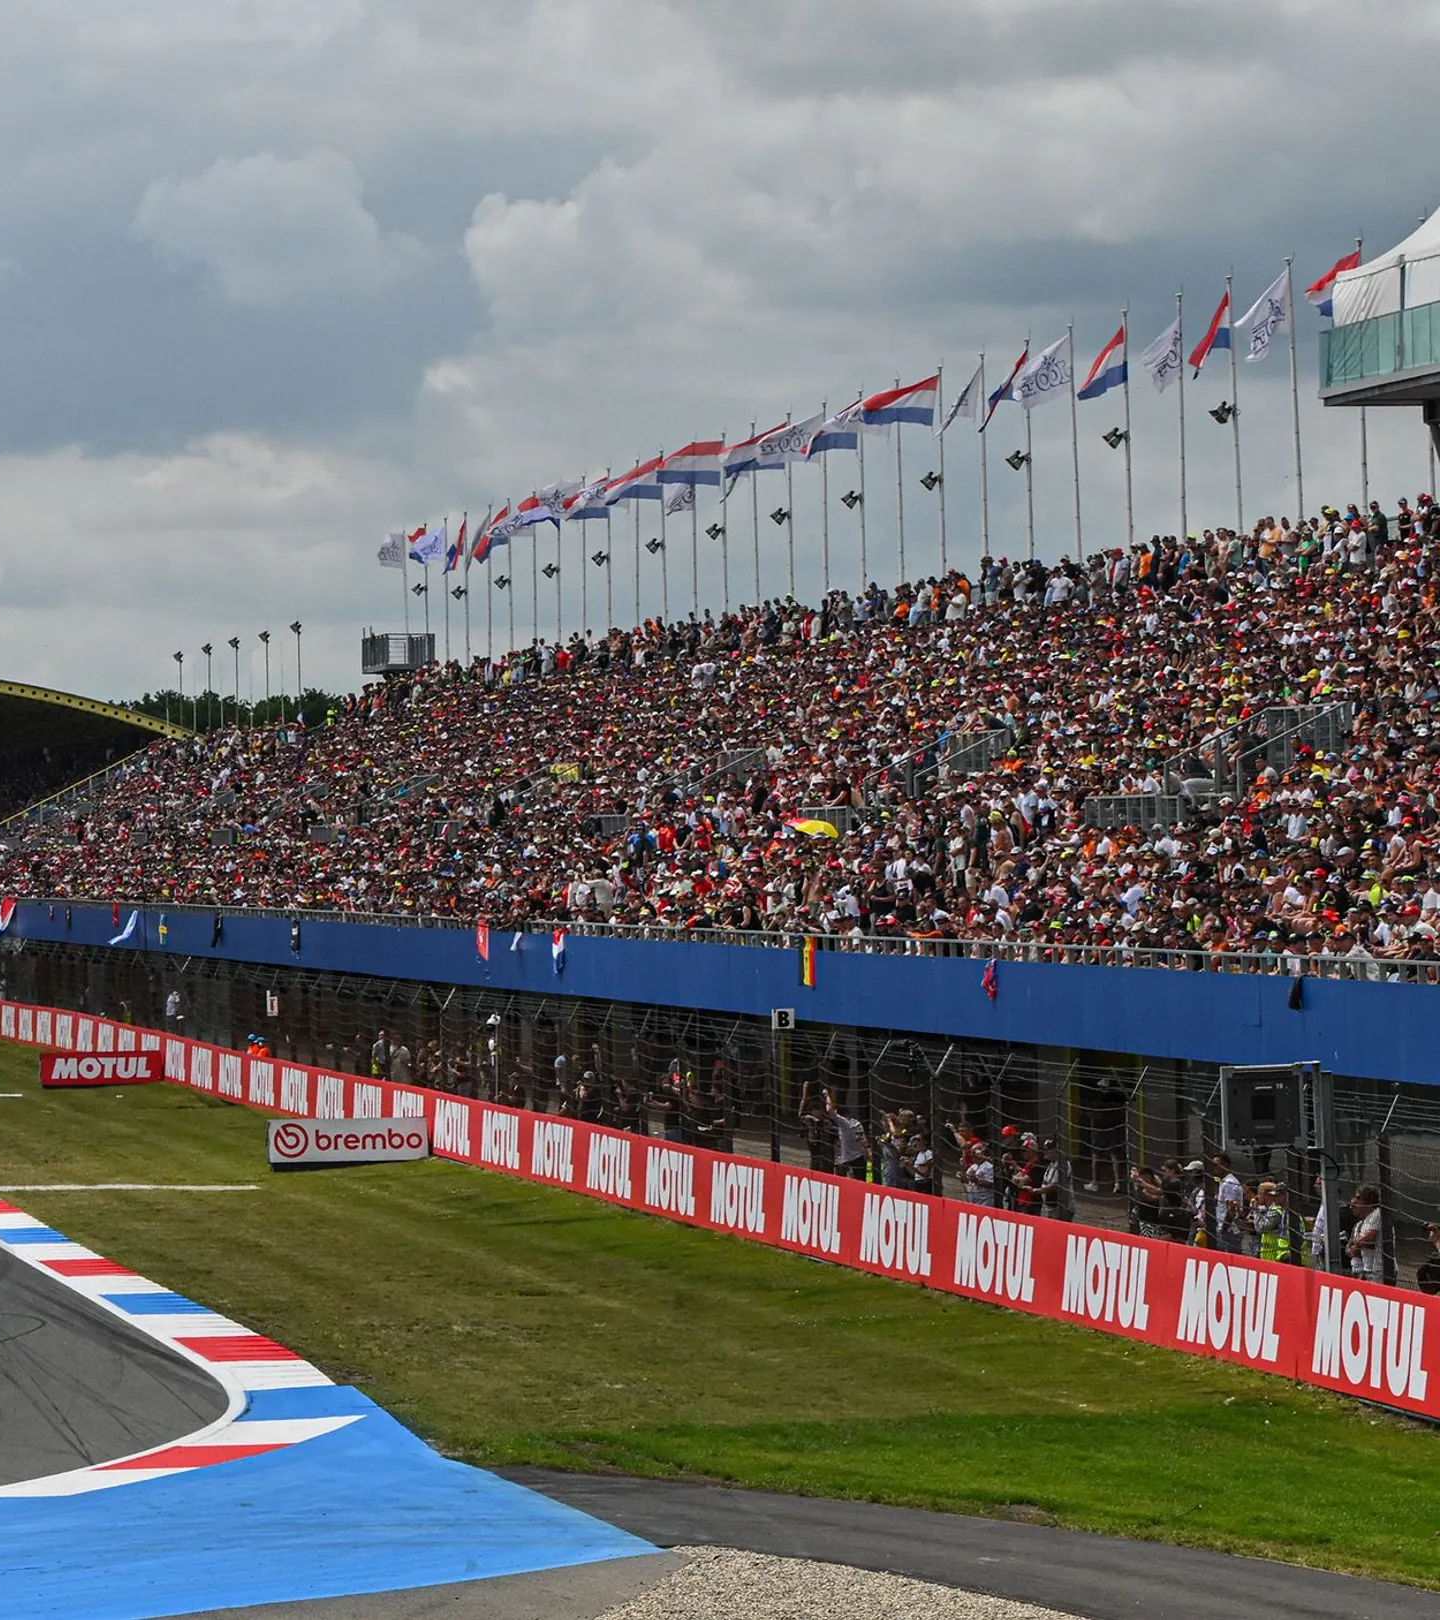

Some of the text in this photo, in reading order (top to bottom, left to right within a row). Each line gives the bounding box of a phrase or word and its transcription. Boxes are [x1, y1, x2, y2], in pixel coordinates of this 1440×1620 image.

[778, 1011, 790, 1027] B
[51, 1057, 151, 1079] MOTUL
[315, 1128, 423, 1151] brembo
[249, 1060, 274, 1106] MOTUL
[280, 1067, 308, 1115] MOTUL
[316, 1075, 344, 1119] MOTUL
[353, 1083, 382, 1118] MOTUL
[434, 1098, 470, 1157] MOTUL
[481, 1110, 519, 1169] MOTUL
[532, 1120, 573, 1182] MOTUL
[586, 1133, 631, 1199] MOTUL
[645, 1147, 695, 1216] MOTUL
[711, 1161, 765, 1233] MOTUL
[781, 1175, 841, 1254] MOTUL
[860, 1193, 932, 1276] MOTUL
[954, 1213, 1034, 1302] MOTUL
[1062, 1235, 1149, 1330] MOTUL
[1176, 1259, 1279, 1362] MOTUL
[1312, 1286, 1427, 1401] MOTUL
